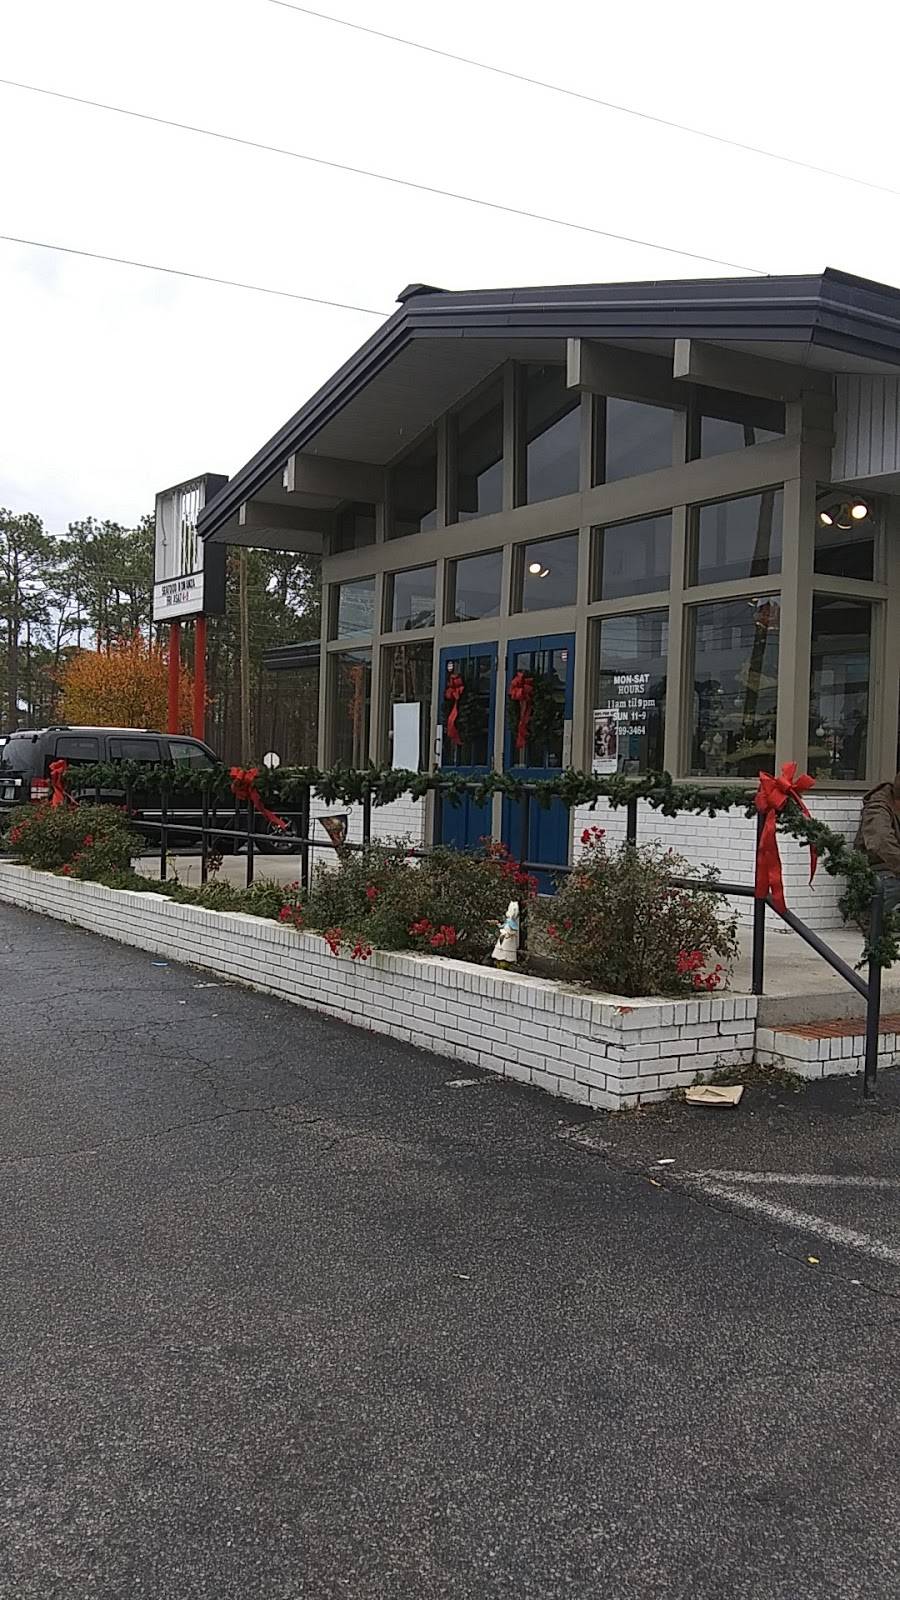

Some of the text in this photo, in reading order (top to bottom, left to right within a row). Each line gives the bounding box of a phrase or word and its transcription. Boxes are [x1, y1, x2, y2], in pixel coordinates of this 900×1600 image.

[613, 674, 650, 684] MON-SAT
[618, 684, 645, 694] HOURS
[607, 699, 627, 709] 11am
[613, 711, 629, 721] SUN
[631, 711, 647, 721] 11-9
